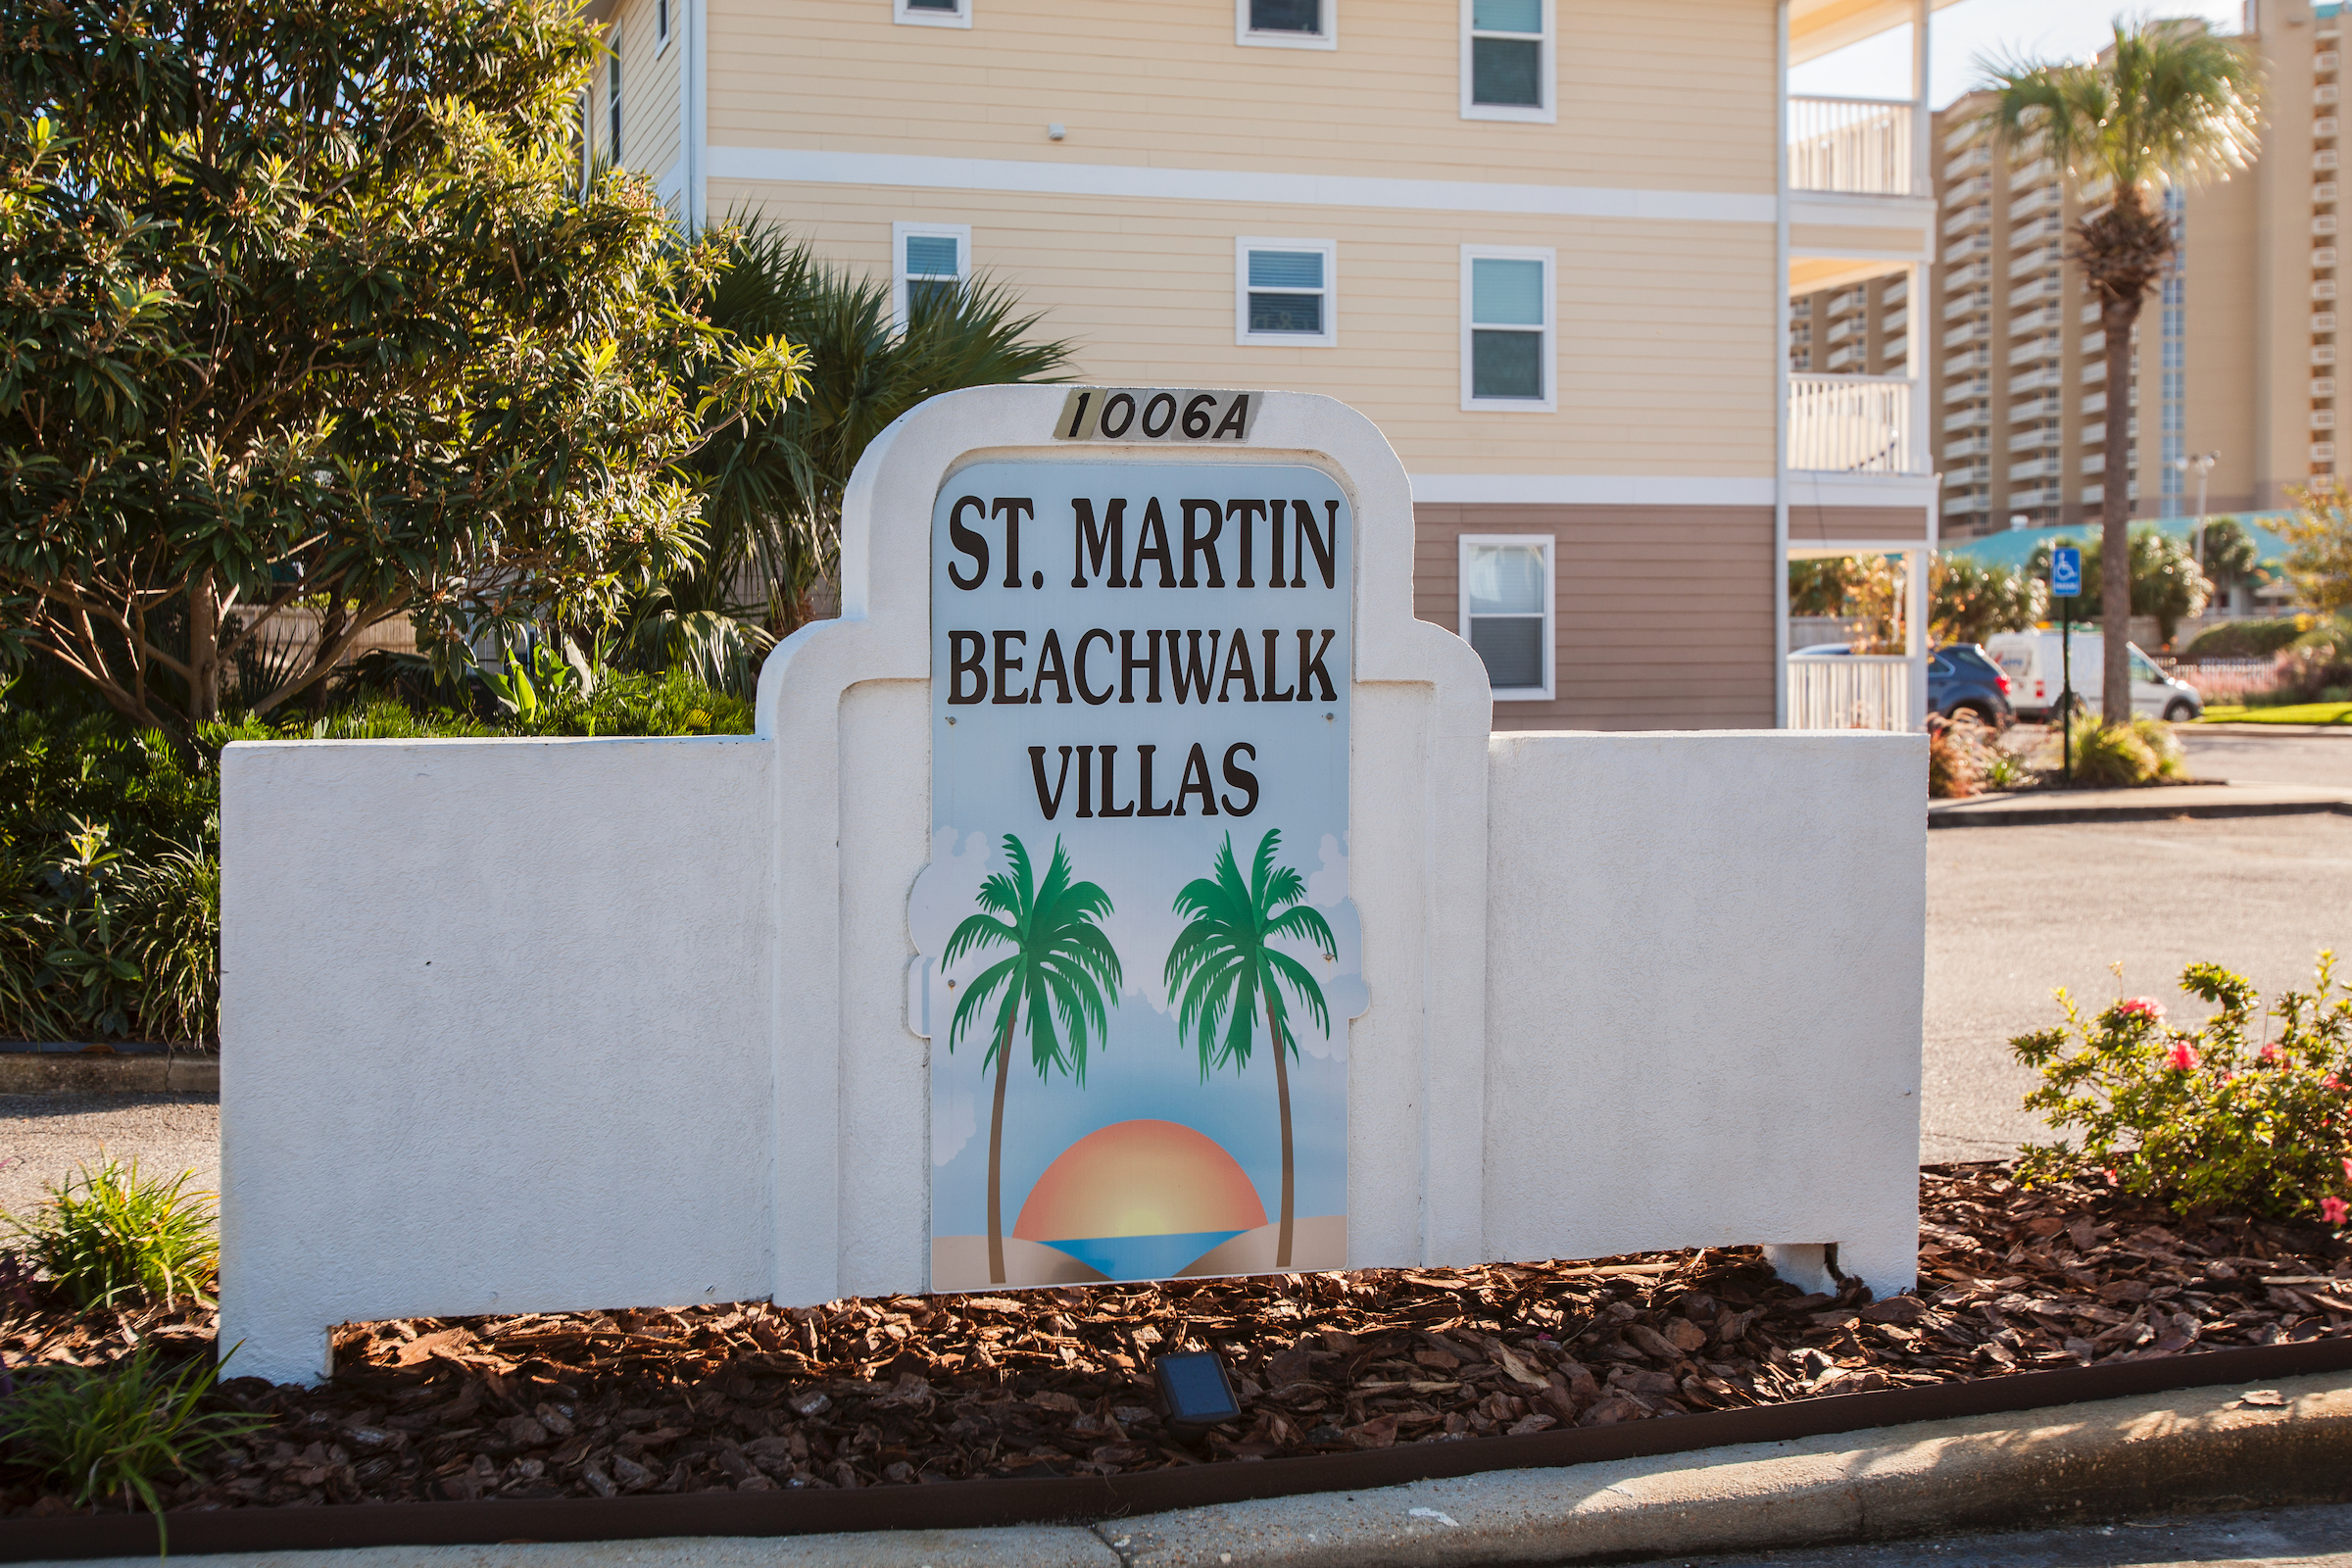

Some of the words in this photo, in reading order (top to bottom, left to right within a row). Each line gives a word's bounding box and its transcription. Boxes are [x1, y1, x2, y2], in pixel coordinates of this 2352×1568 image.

[1067, 392, 1250, 439] 1006A
[948, 495, 1044, 591] ST.
[1070, 496, 1340, 590] MARTIN
[947, 627, 1339, 706] BEACHWALK
[1027, 741, 1260, 821] VILLAS
